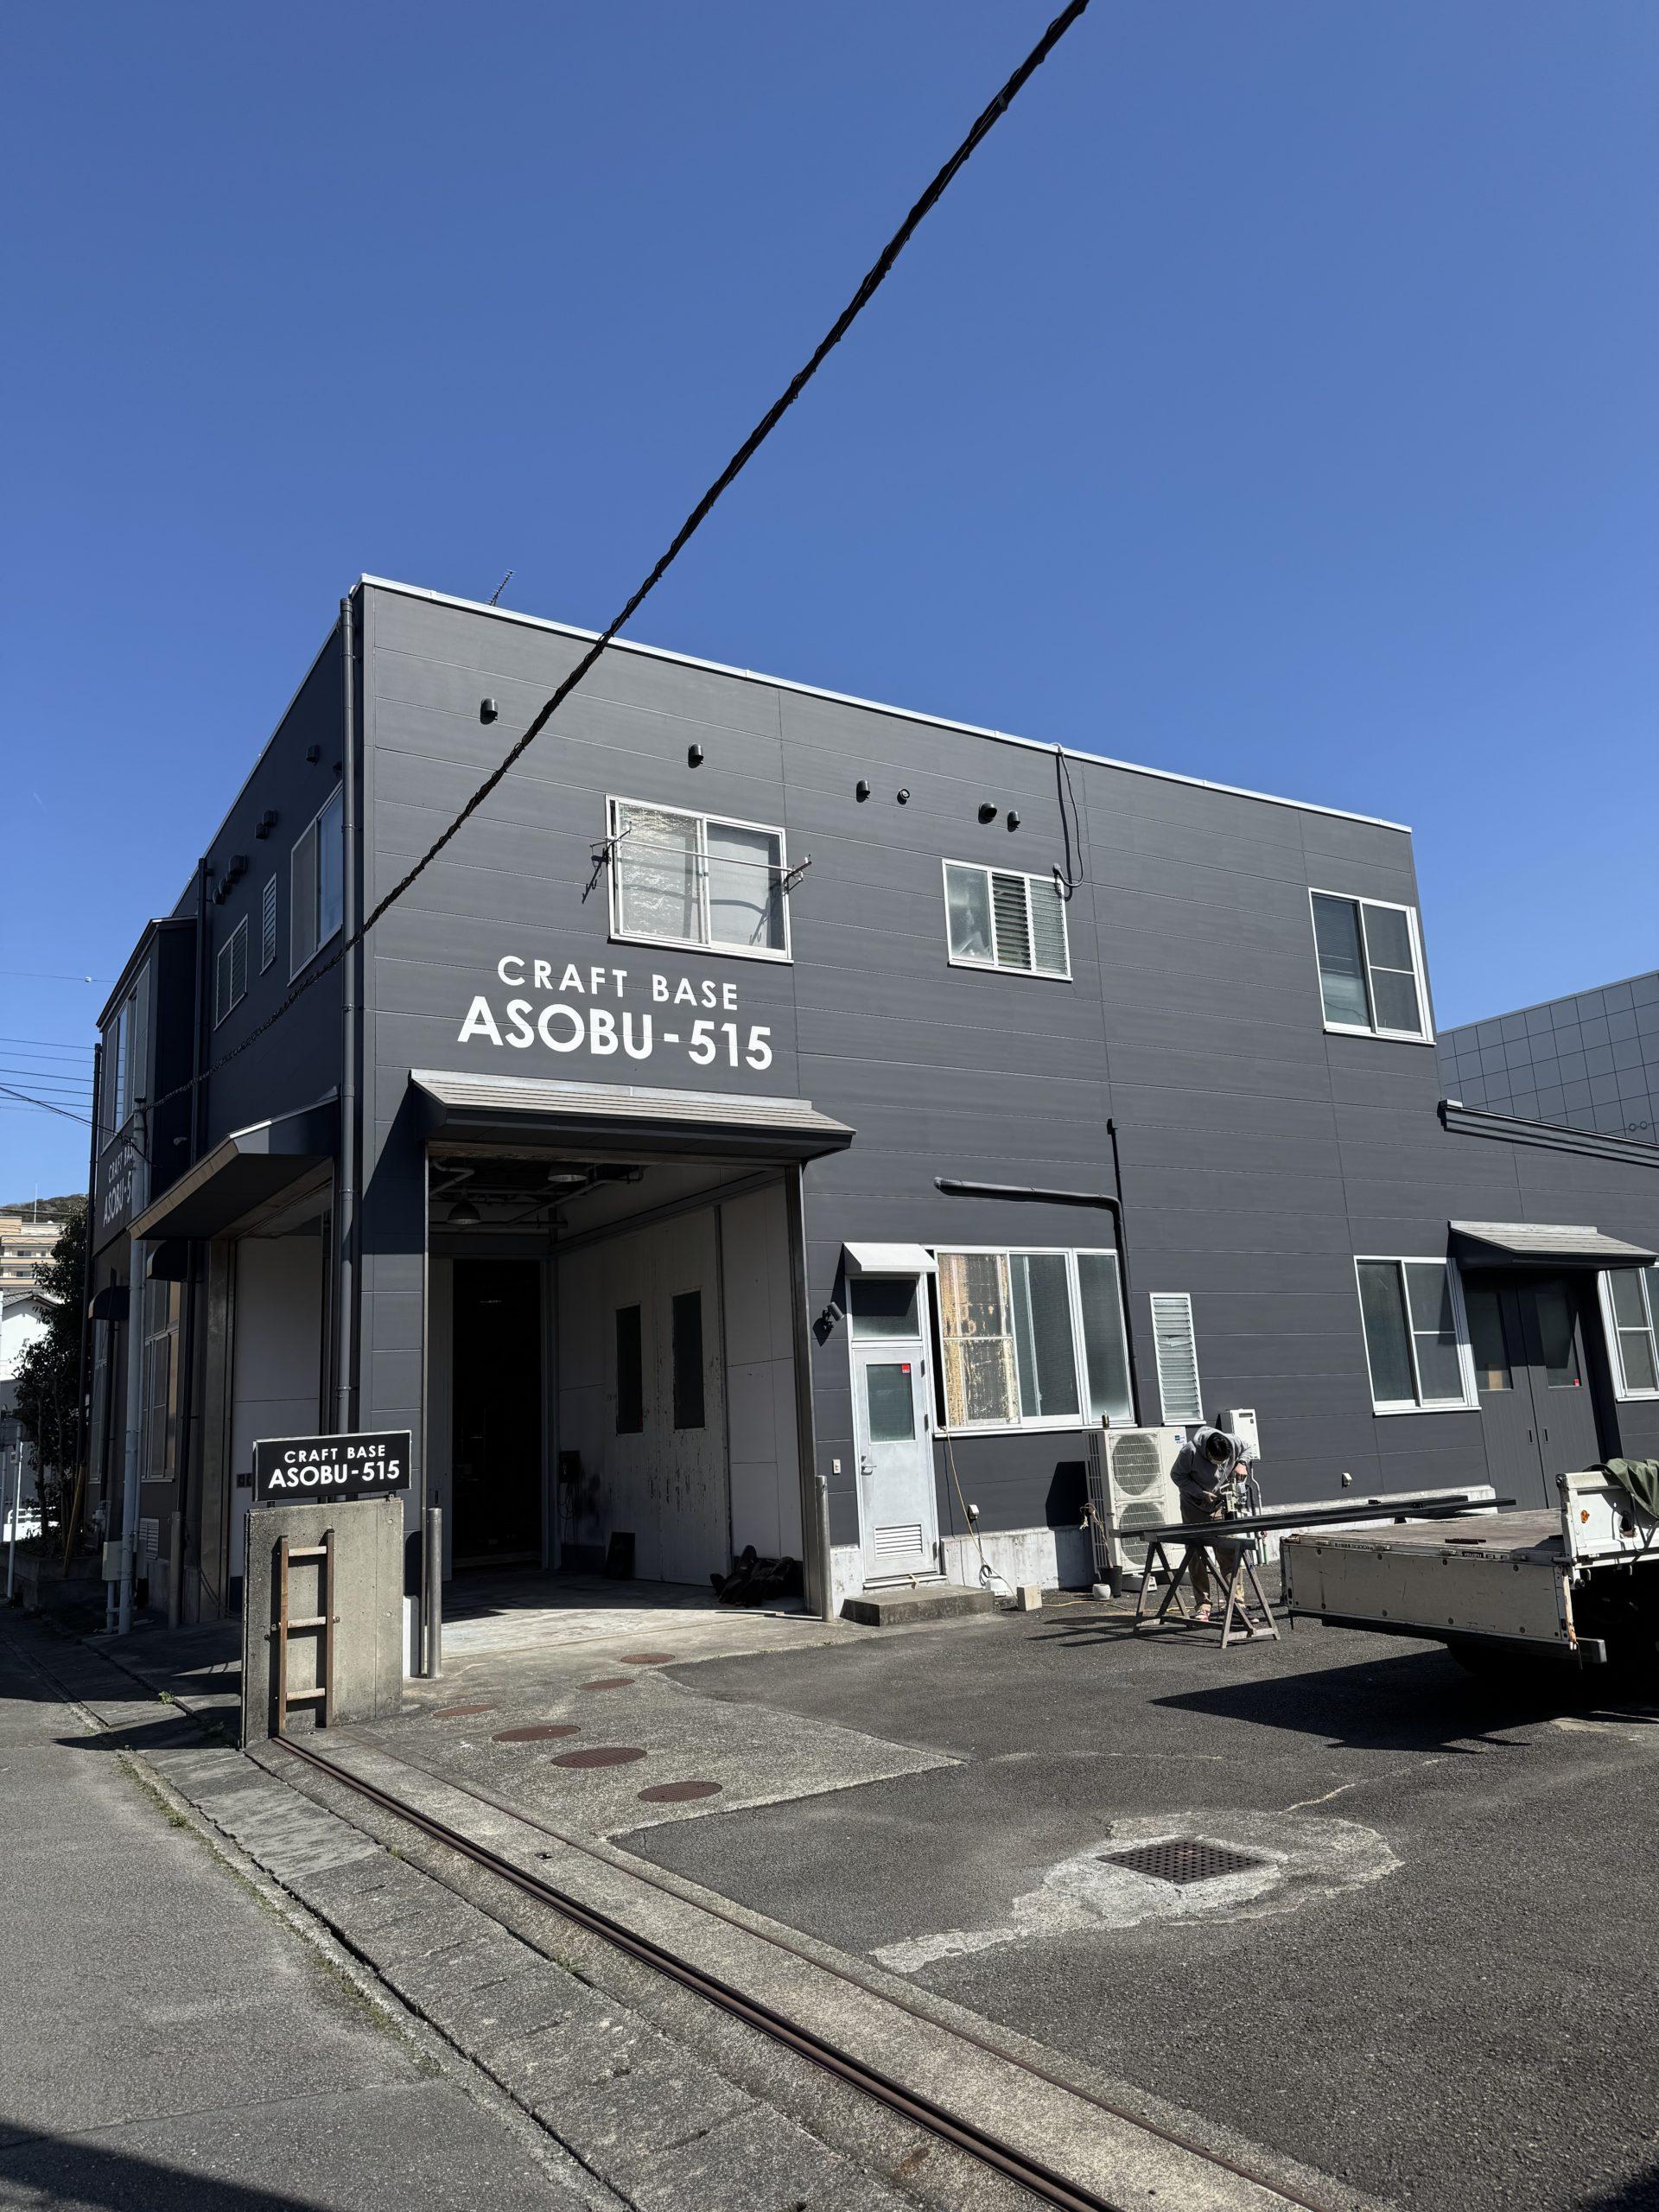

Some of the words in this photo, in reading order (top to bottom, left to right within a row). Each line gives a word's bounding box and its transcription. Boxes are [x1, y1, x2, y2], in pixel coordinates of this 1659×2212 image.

[497, 955, 628, 998] CRAFT
[652, 974, 738, 1011] BASE
[457, 995, 772, 1071] ASOBU-515
[108, 1151, 123, 1184] CRAFT
[124, 1139, 135, 1166] BAS
[103, 1170, 132, 1227] ASOBU-5
[268, 1459, 400, 1489] ASOBU-515
[283, 1447, 339, 1464] CRAFT
[346, 1444, 386, 1459] BASE
